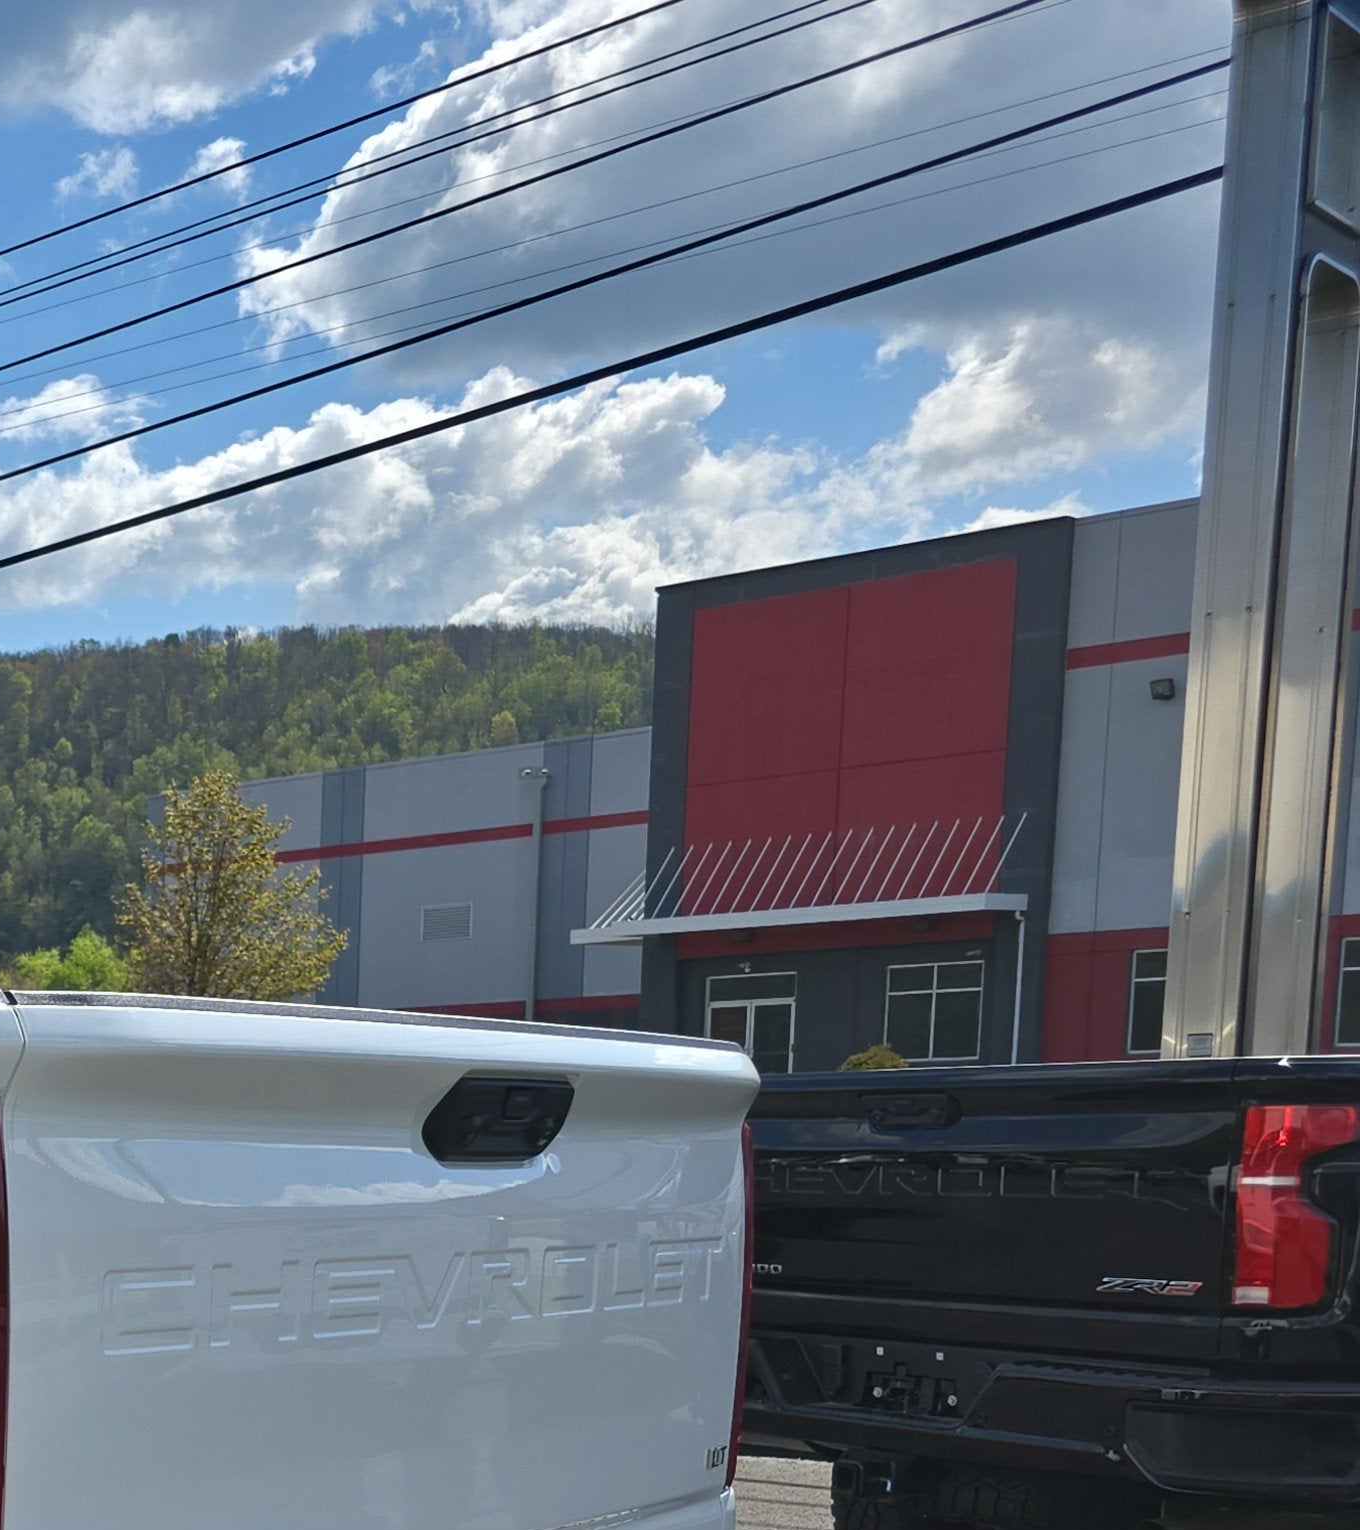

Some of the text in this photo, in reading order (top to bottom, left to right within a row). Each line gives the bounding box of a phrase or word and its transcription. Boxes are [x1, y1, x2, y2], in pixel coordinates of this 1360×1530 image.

[753, 1159, 1178, 1201] HEVROLET
[103, 1233, 725, 1355] CHEVROLET
[1096, 1277, 1203, 1297] ZR2
